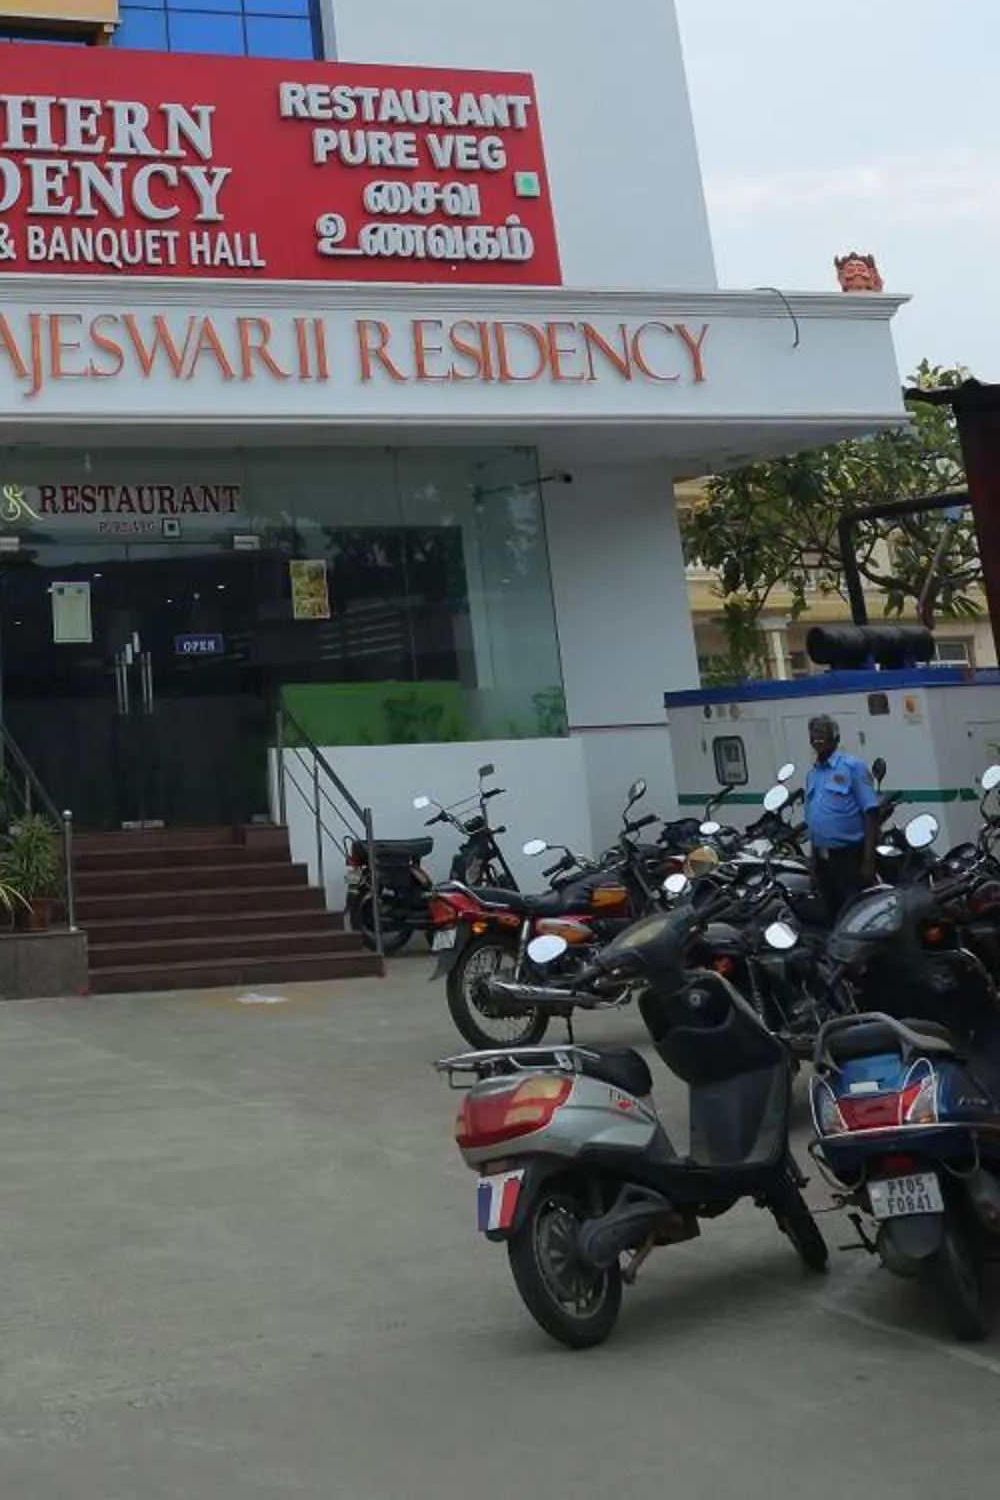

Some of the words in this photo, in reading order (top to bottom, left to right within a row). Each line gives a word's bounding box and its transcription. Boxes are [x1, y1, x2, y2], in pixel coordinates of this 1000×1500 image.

[279, 81, 532, 130] RESTAURANT
[313, 127, 419, 168] PURE
[425, 133, 507, 171] VEG
[364, 180, 482, 217] சைவ
[28, 225, 181, 269] BANQUET
[189, 231, 267, 268] HALL
[315, 212, 535, 262] உணவகம்
[355, 318, 710, 385] RESIDENCY
[38, 485, 241, 514] RESTAURANT
